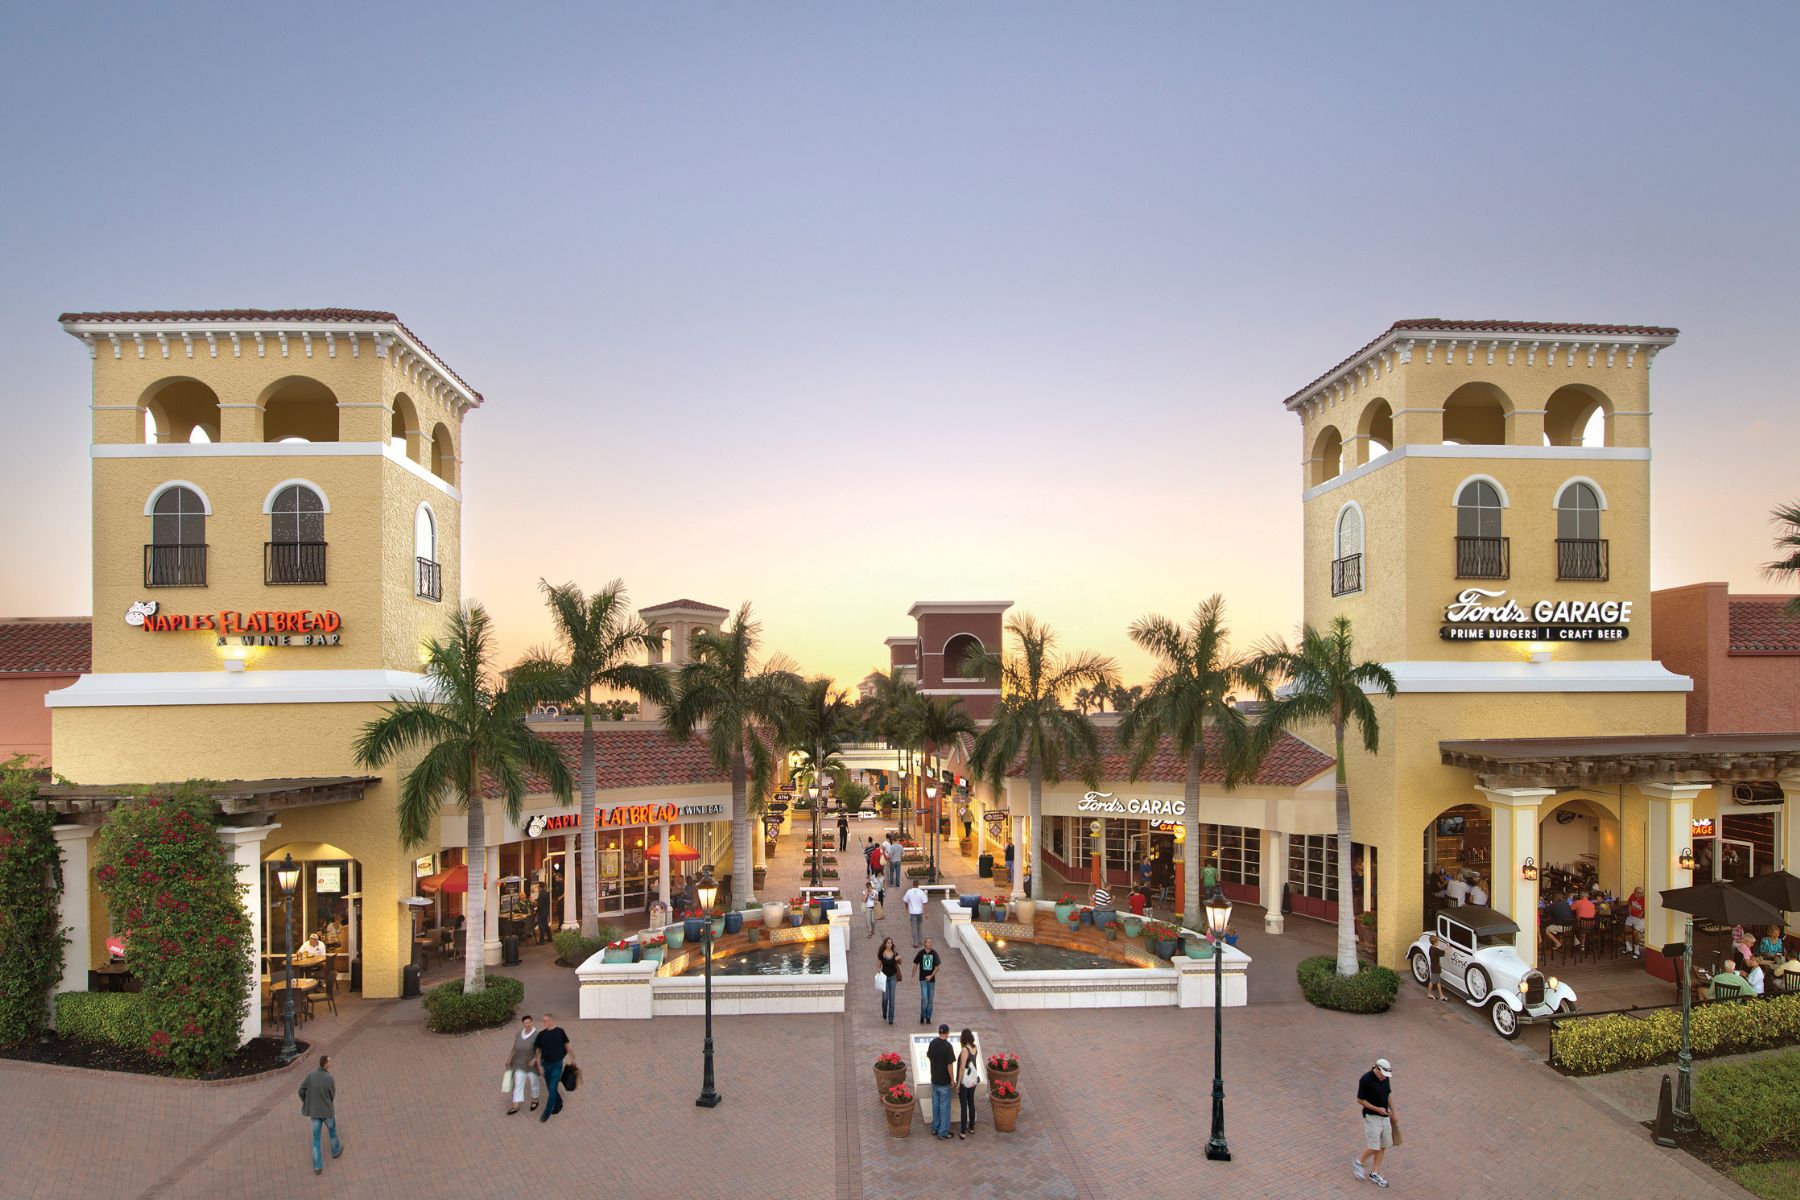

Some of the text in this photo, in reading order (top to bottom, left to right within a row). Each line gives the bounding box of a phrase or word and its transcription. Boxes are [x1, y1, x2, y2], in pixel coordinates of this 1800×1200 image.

[1447, 587, 1633, 623] Ford's GARAGE
[143, 609, 341, 635] NAPLES FLATBREAD
[1450, 628, 1623, 639] PRIME BURGERS CRAFT BEER
[217, 634, 340, 646] & WINE BAR
[1078, 791, 1185, 815] Ford's GARAG
[546, 813, 581, 831] NAPL
[594, 802, 679, 831] FLATBREAD
[685, 804, 706, 815] WINE
[1692, 826, 1712, 835] RAGE
